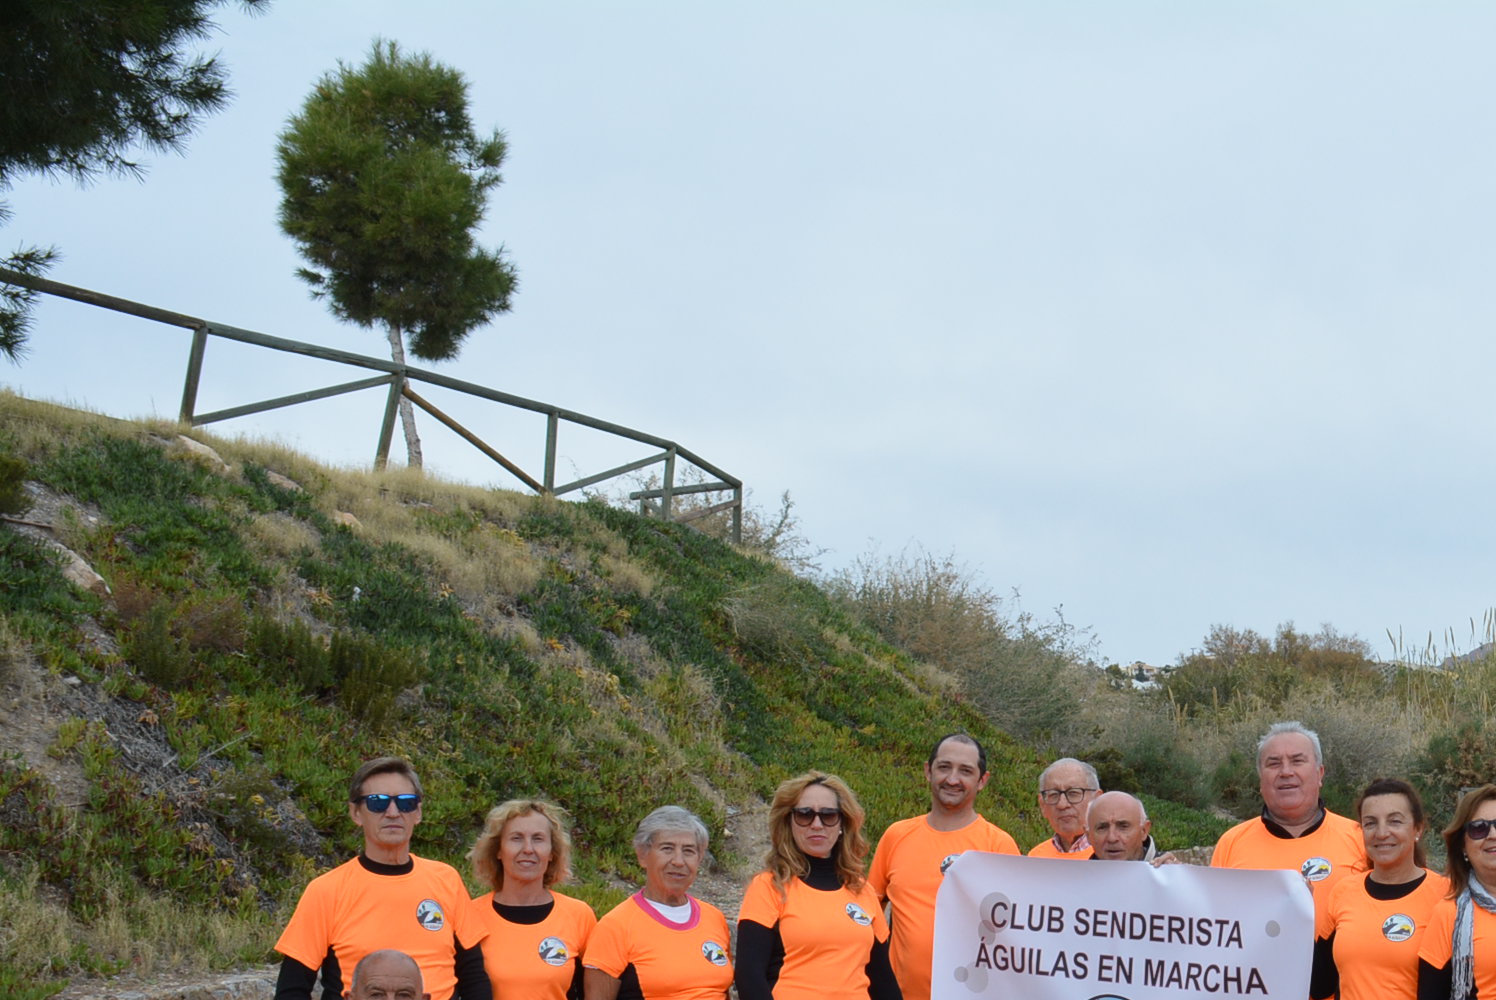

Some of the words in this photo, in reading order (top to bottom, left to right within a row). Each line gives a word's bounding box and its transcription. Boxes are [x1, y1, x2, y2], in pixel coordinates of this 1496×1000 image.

[991, 902, 1064, 933] CLUB
[1074, 908, 1244, 949] SENDERISTA
[975, 937, 1089, 980] ÁGUILAS
[1098, 954, 1133, 984] EN
[1144, 958, 1269, 995] MARCHA
